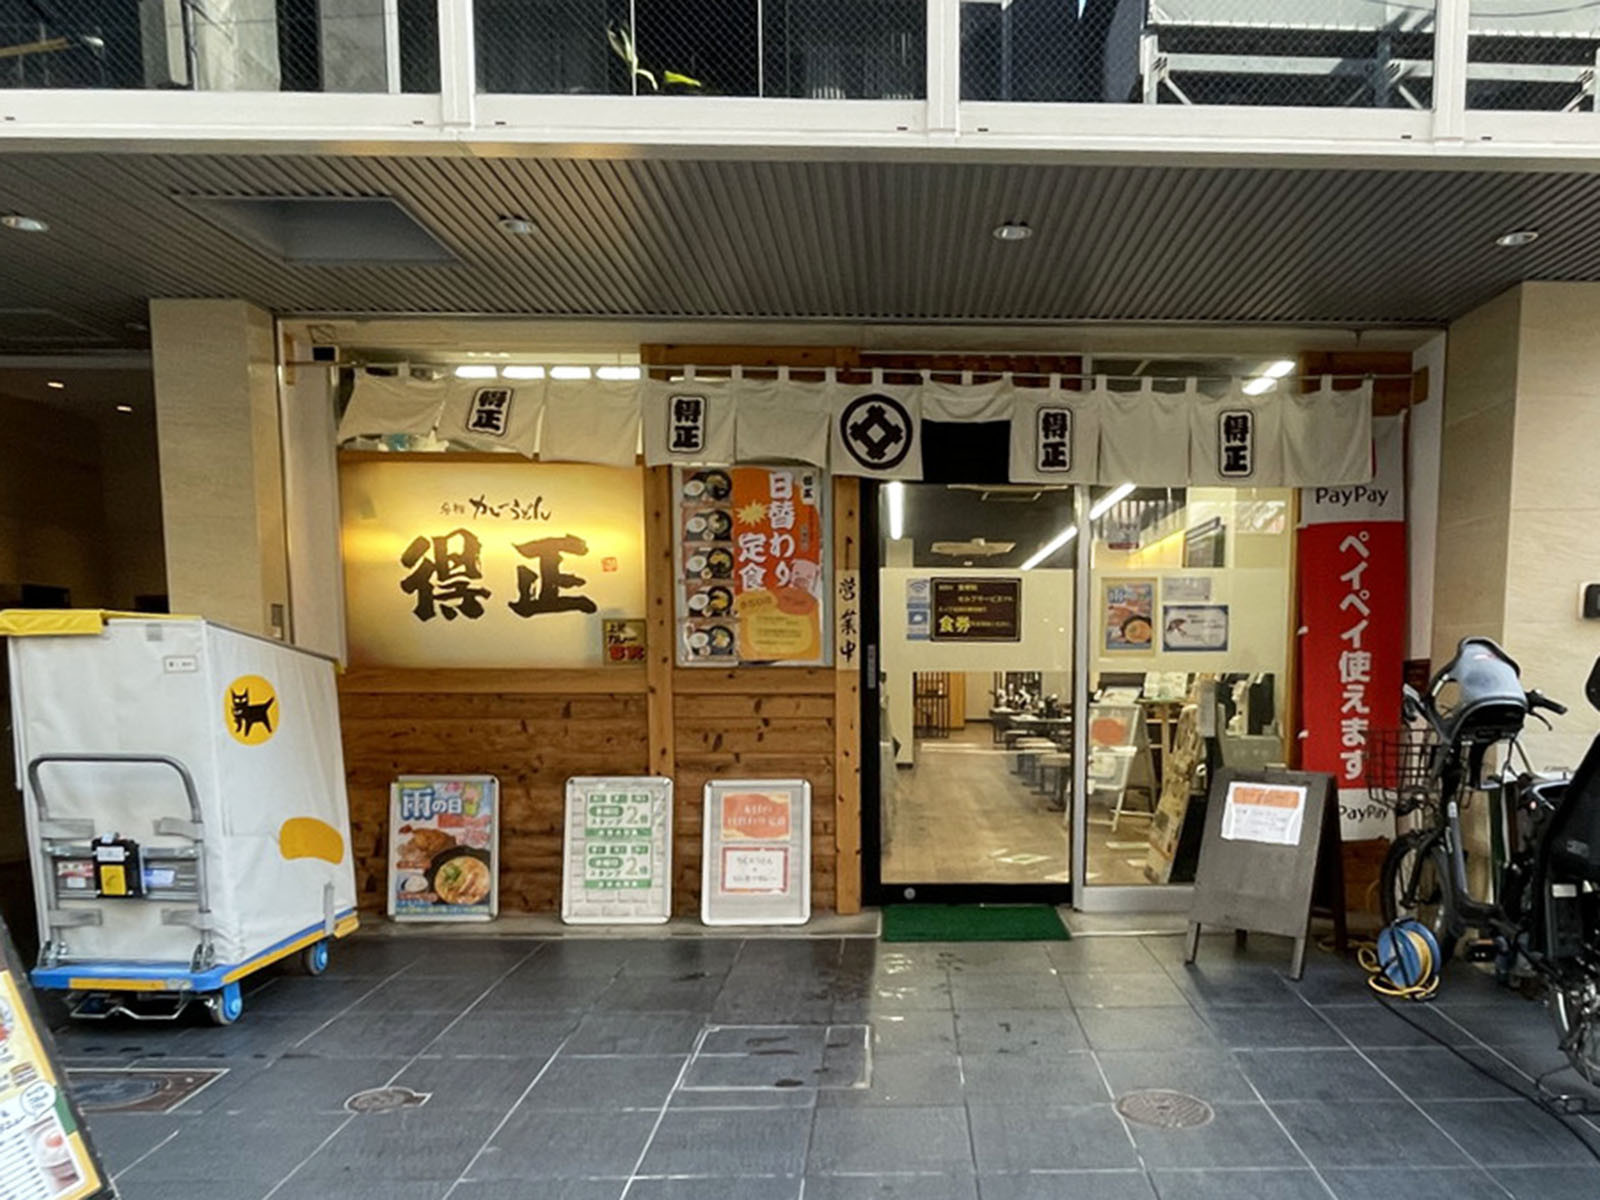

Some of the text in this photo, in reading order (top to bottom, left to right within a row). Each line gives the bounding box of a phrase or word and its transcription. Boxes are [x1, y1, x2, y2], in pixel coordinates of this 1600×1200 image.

[472, 390, 507, 431] 得正
[673, 399, 702, 449] 得正
[1041, 411, 1068, 469] 得正
[1223, 414, 1249, 473] 得正
[1315, 486, 1389, 506] PayPay
[400, 528, 598, 622] 得正
[738, 532, 767, 591] 定食
[839, 576, 857, 662] 営業中
[938, 615, 971, 633] 食券
[1339, 530, 1371, 780] ペイペイ使えます
[401, 786, 463, 819] 雨の日
